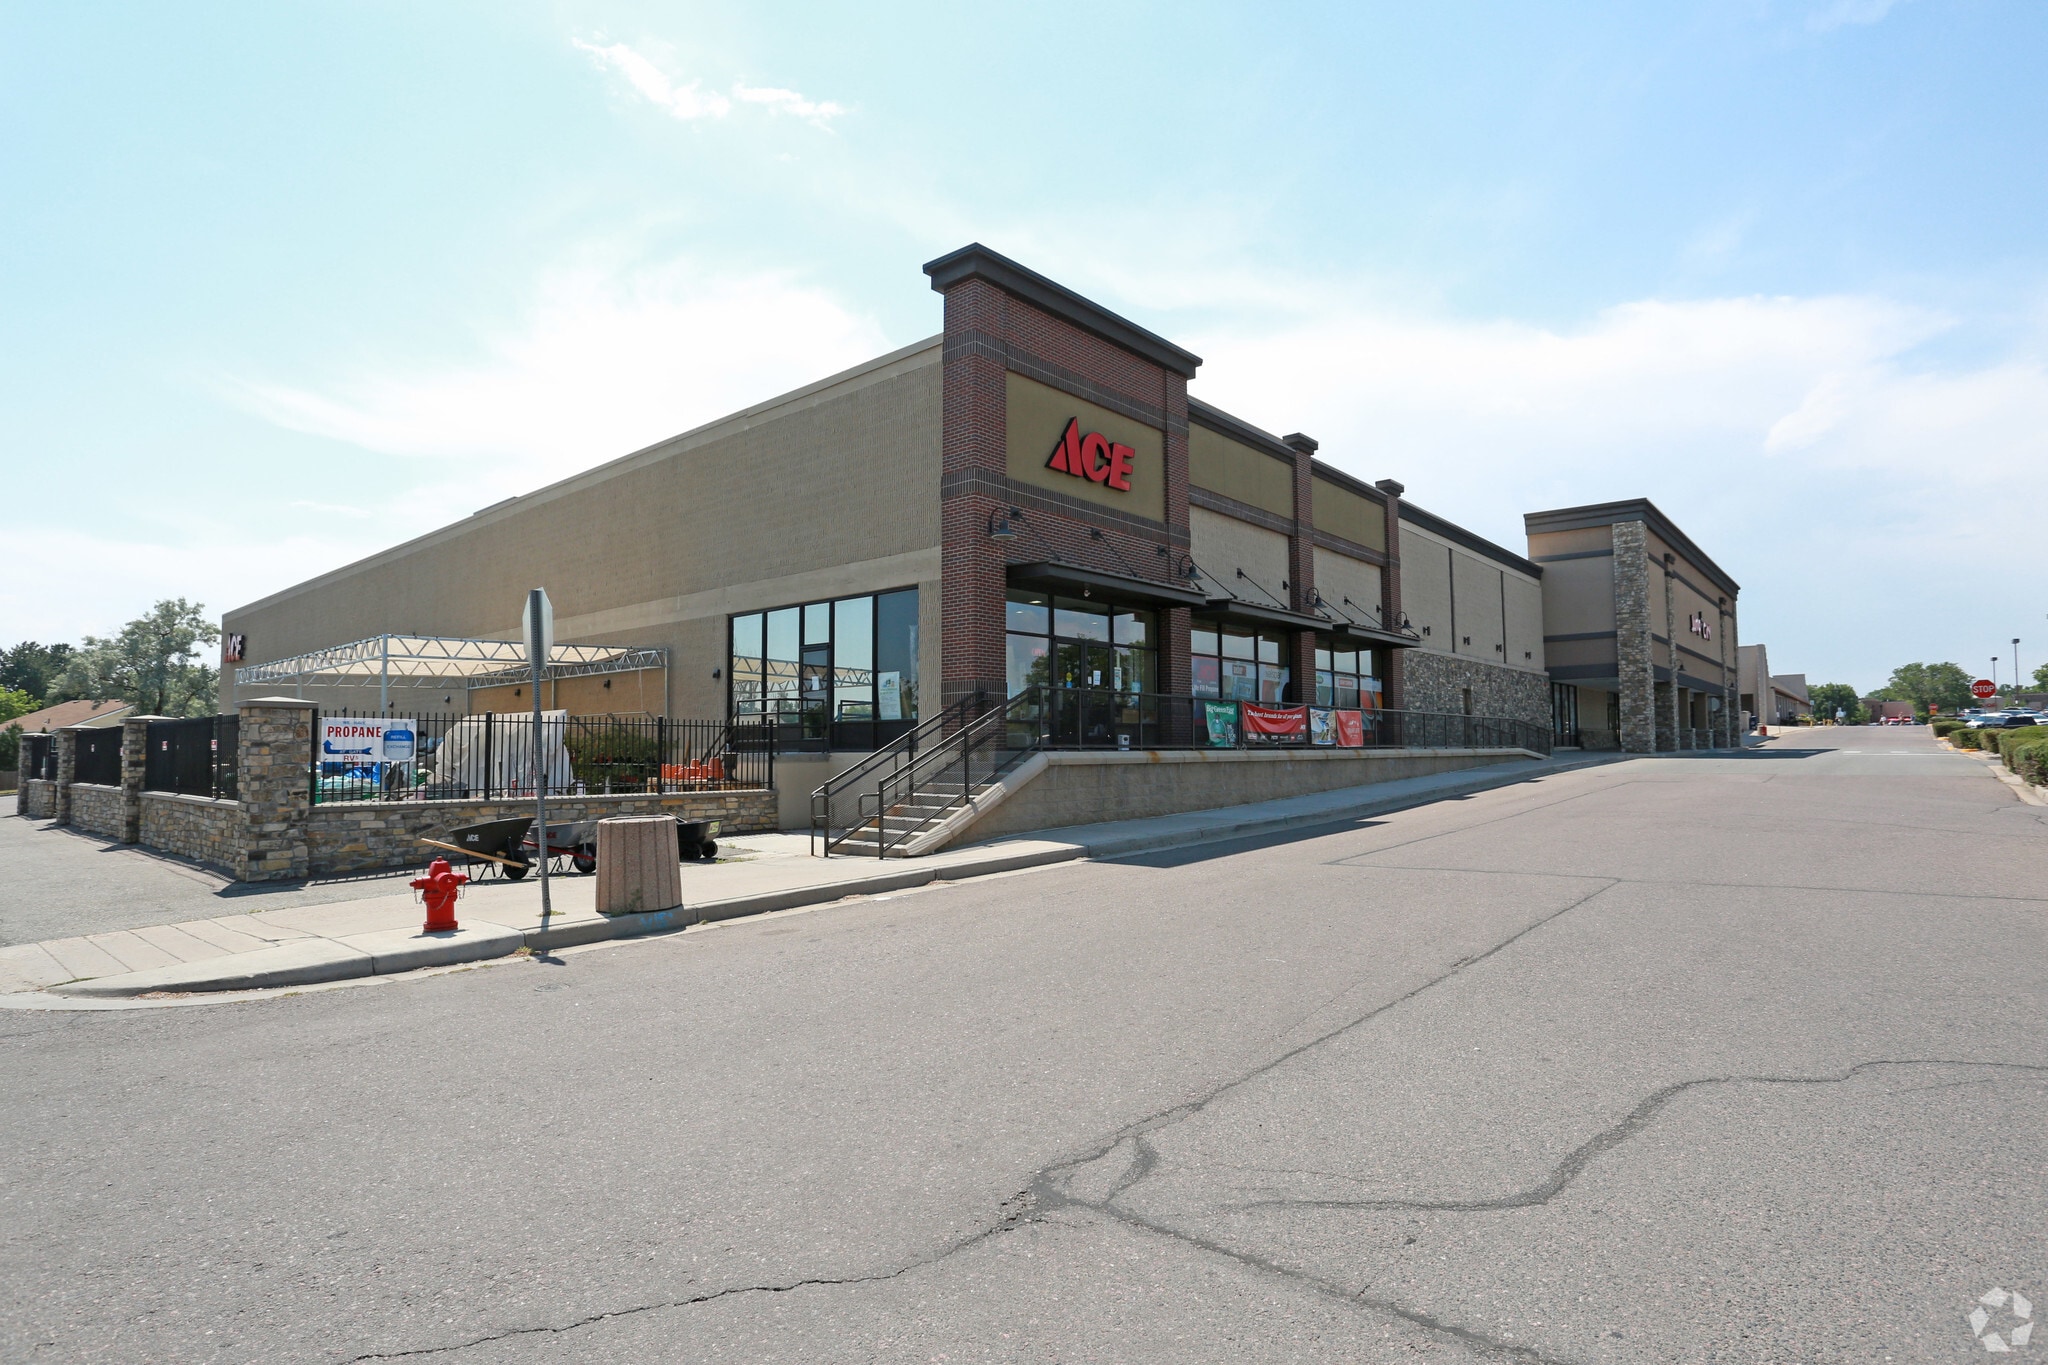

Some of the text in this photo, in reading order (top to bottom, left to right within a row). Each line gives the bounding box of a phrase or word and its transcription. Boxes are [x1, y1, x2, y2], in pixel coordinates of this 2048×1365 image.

[1044, 416, 1135, 491] ACE
[1973, 685, 1995, 693] STOP
[1206, 704, 1214, 713] Big
[1214, 705, 1226, 713] Green
[327, 726, 382, 737] PROPANE
[466, 834, 479, 842] ACE
